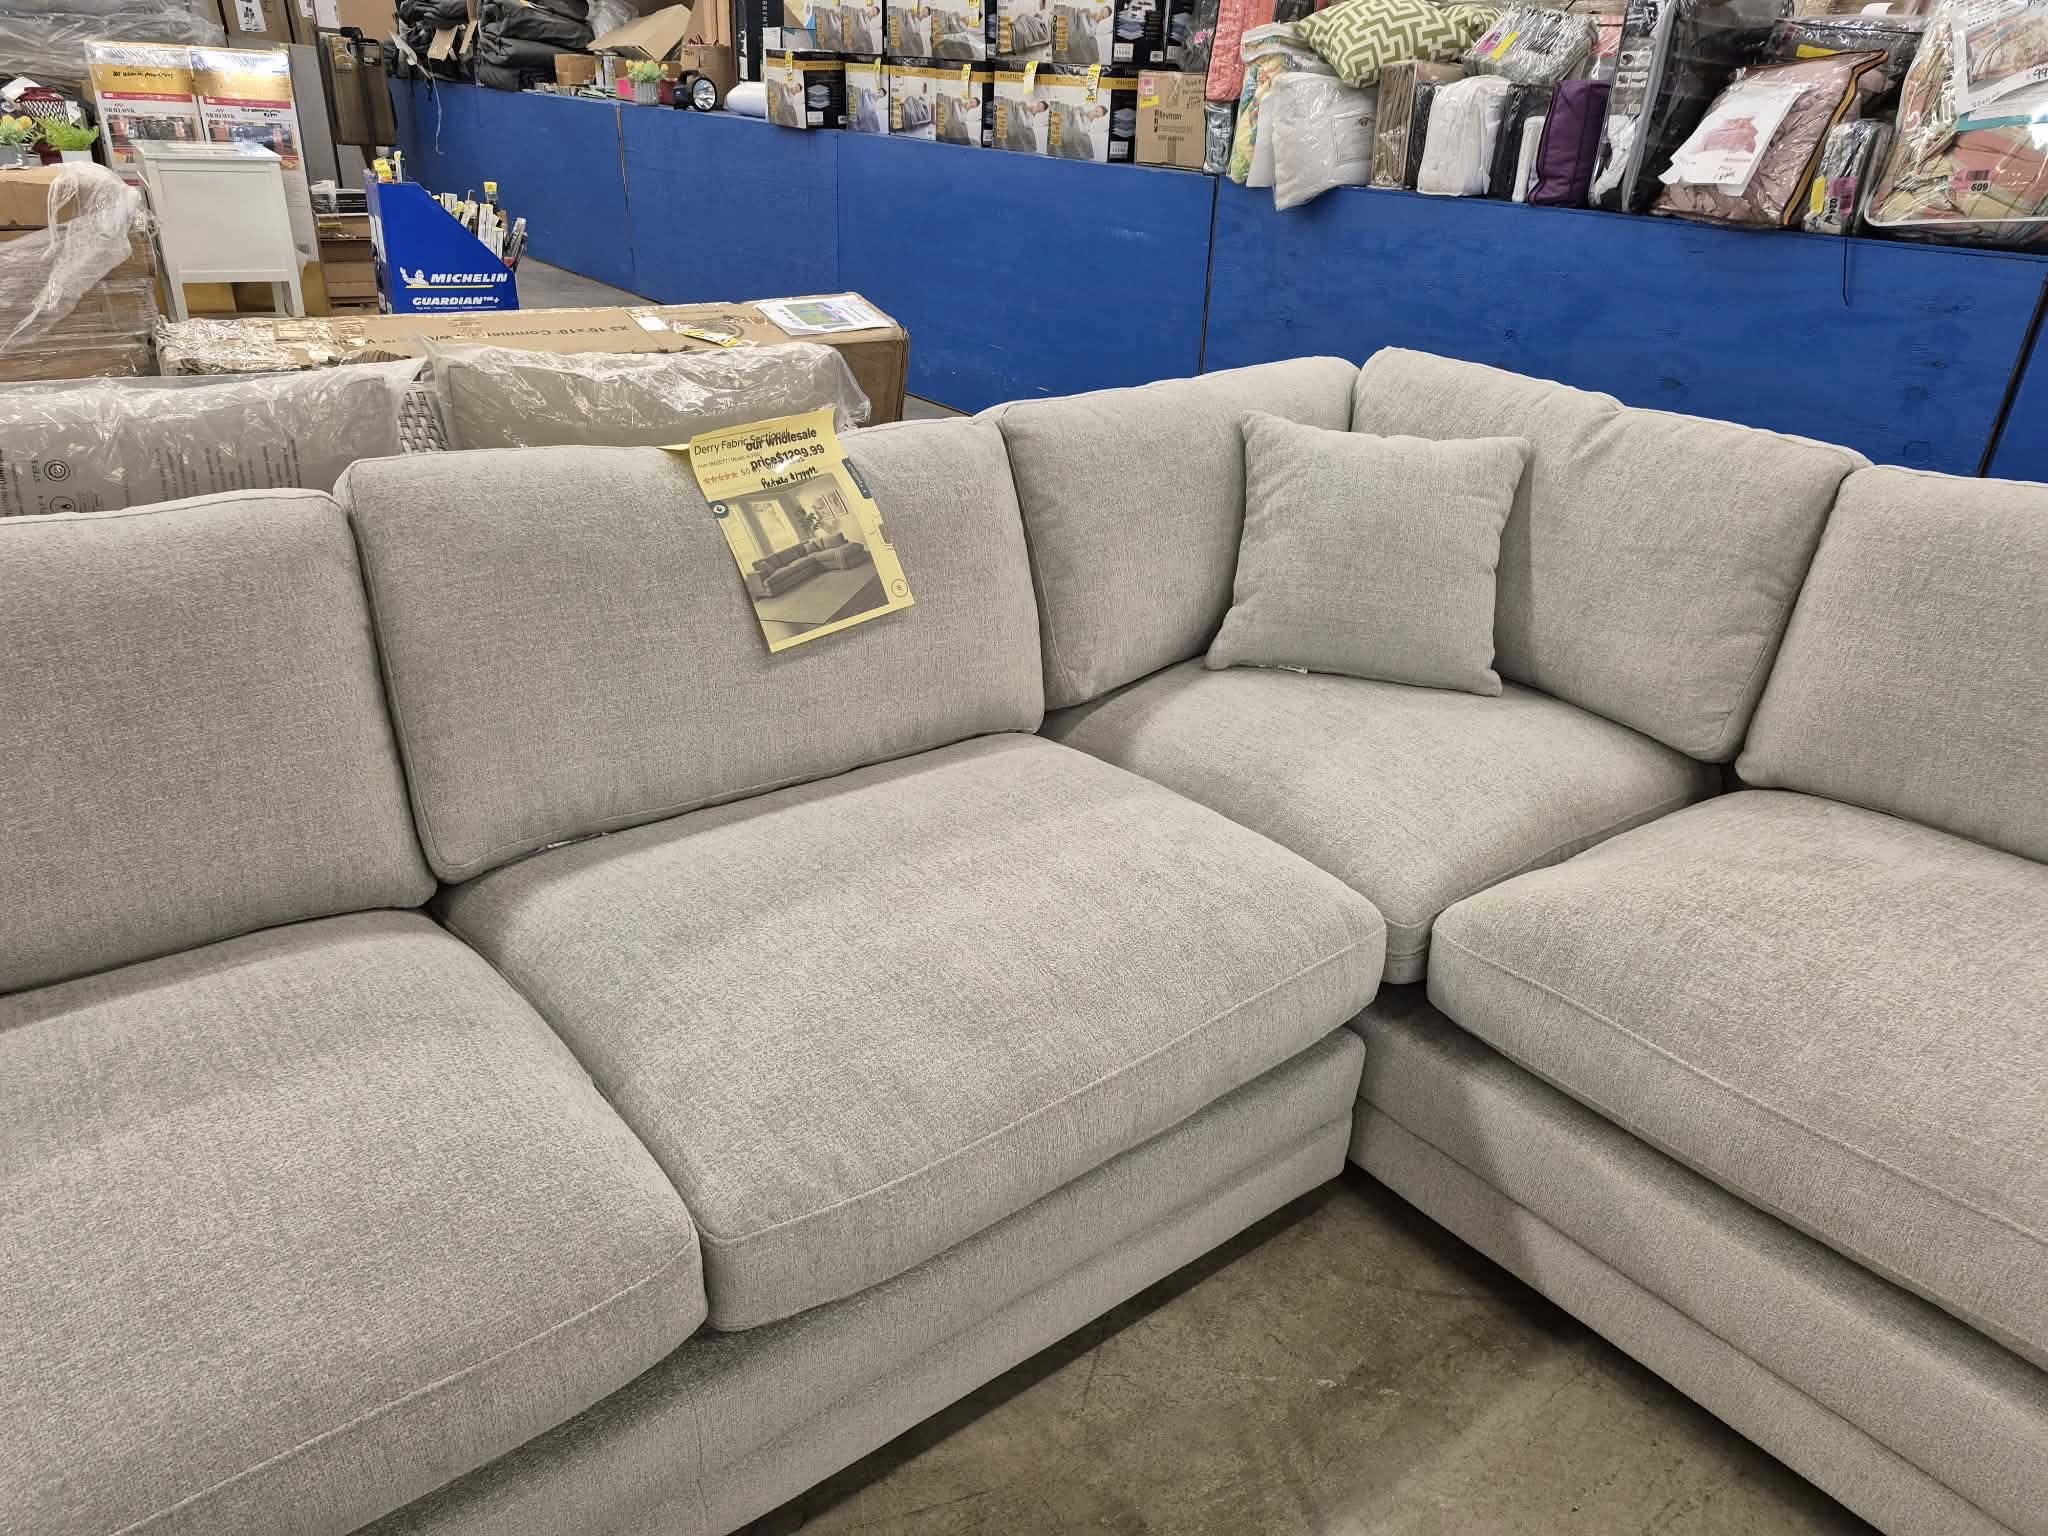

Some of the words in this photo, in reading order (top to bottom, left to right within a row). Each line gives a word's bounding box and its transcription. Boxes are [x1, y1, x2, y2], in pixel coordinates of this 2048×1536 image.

[430, 272, 508, 284] MICHELIN
[694, 442, 720, 456] Derry
[721, 437, 747, 450] Fabric
[766, 427, 817, 449] wholesale
